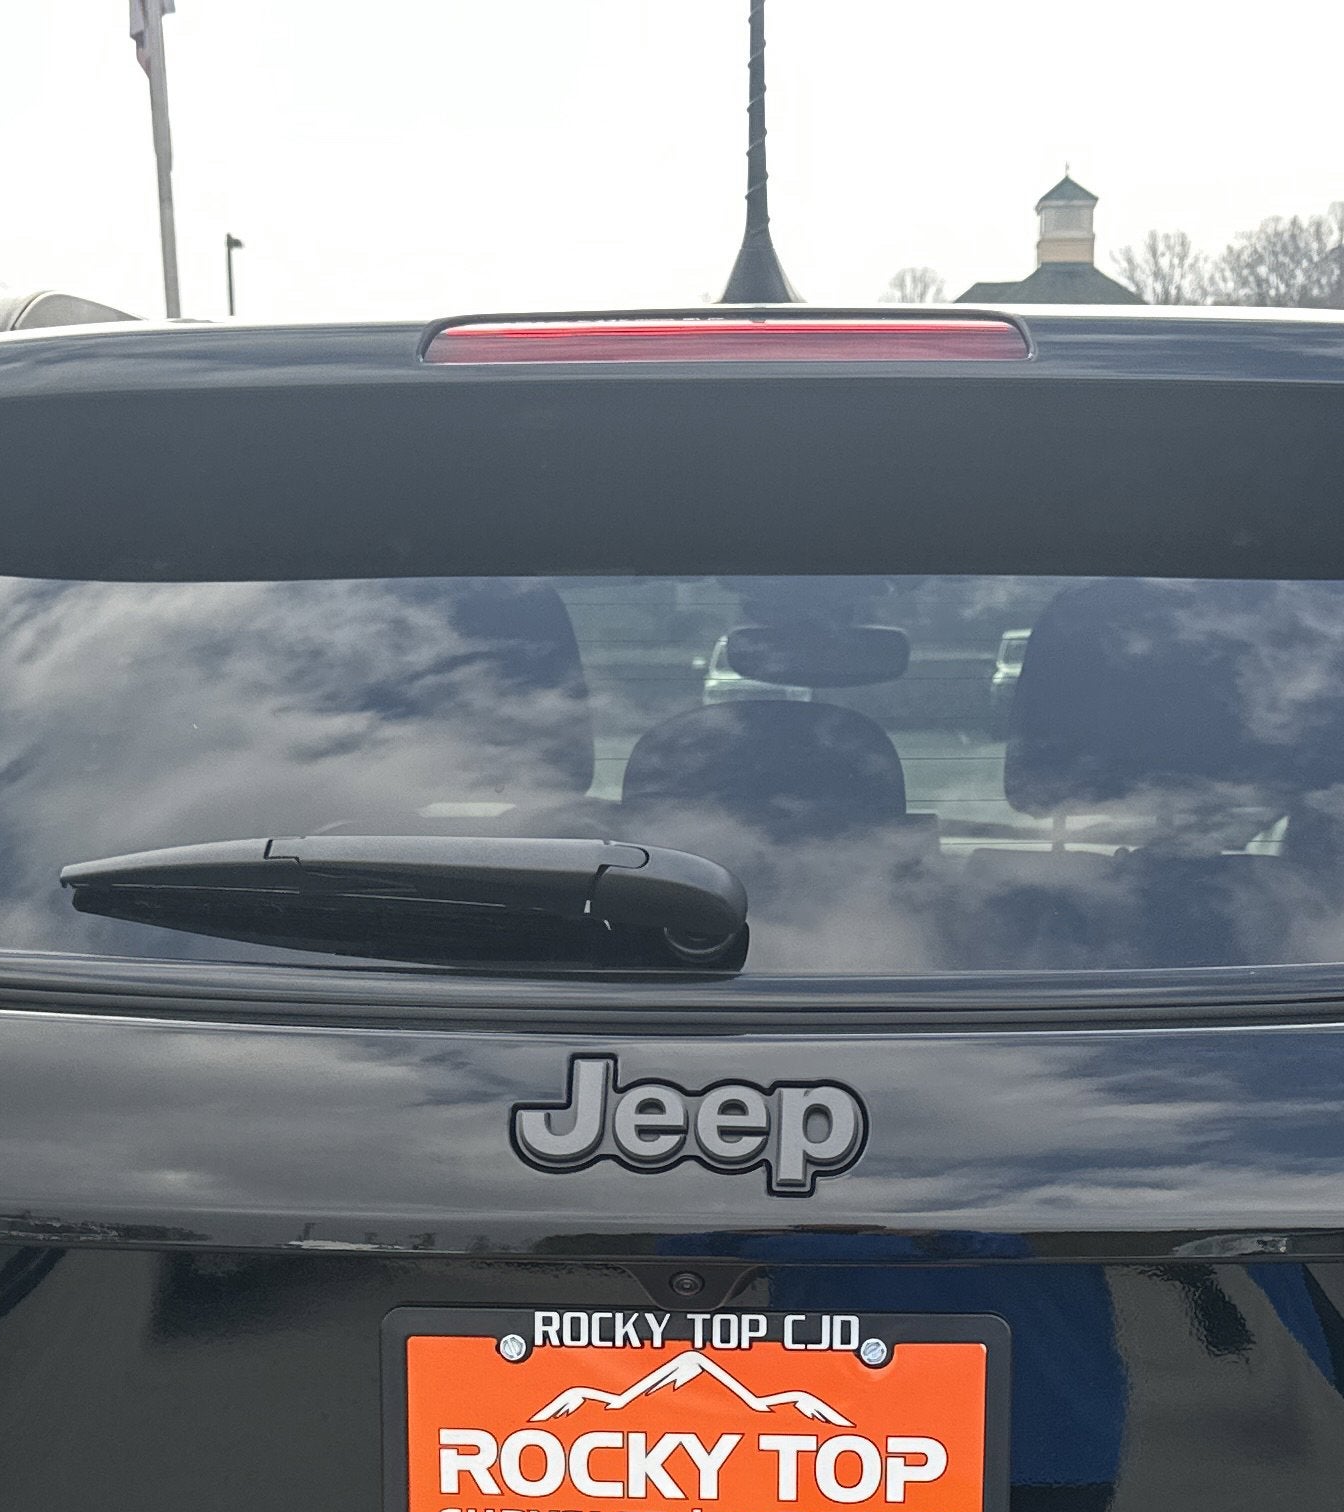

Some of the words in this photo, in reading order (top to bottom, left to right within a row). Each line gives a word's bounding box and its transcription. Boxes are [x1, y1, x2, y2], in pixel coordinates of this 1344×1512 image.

[512, 1055, 866, 1194] Jeep
[533, 1310, 670, 1349] ROCKY
[686, 1313, 768, 1351] TOP
[783, 1315, 861, 1352] CJD
[438, 1427, 744, 1501] ROCKY
[758, 1433, 949, 1504] TOP
